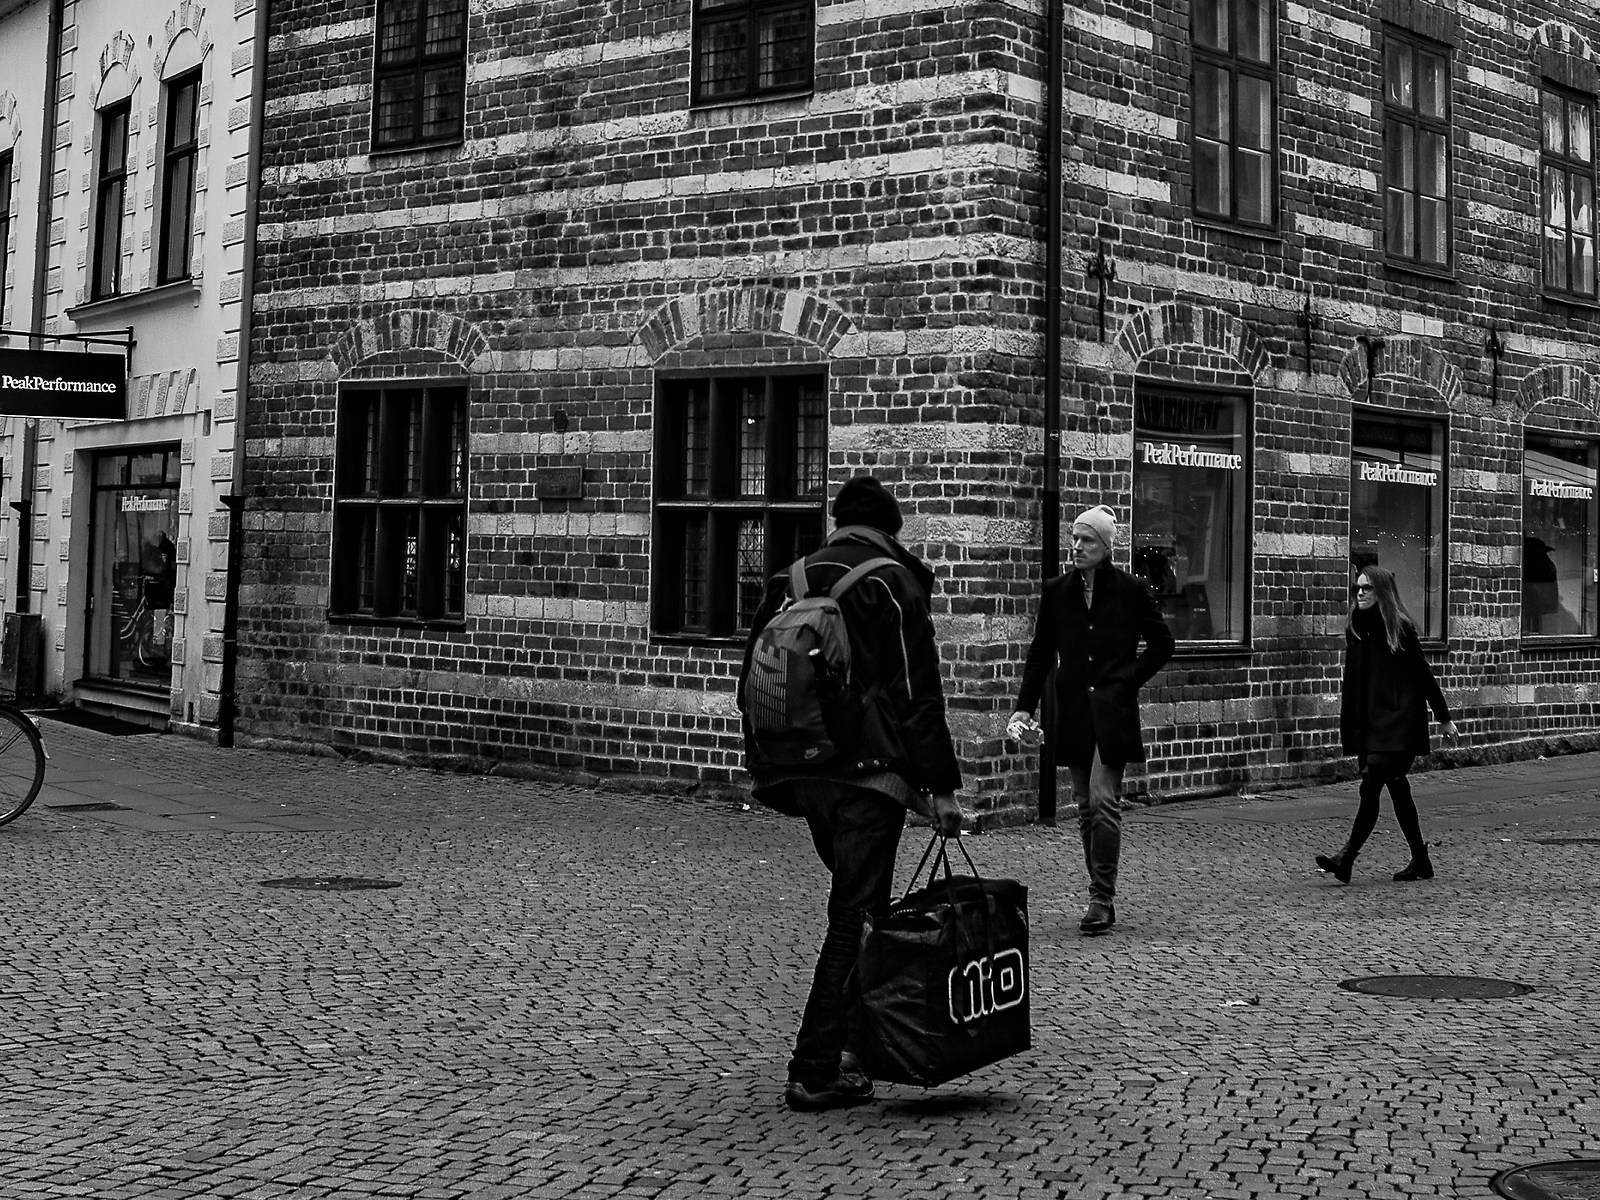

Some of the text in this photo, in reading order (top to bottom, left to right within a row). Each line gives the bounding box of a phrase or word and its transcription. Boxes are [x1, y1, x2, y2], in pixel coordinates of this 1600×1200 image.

[2, 375, 116, 393] PeakPerformance
[1143, 442, 1242, 469] PeakPerformance
[1360, 461, 1437, 486] PeakPerformance
